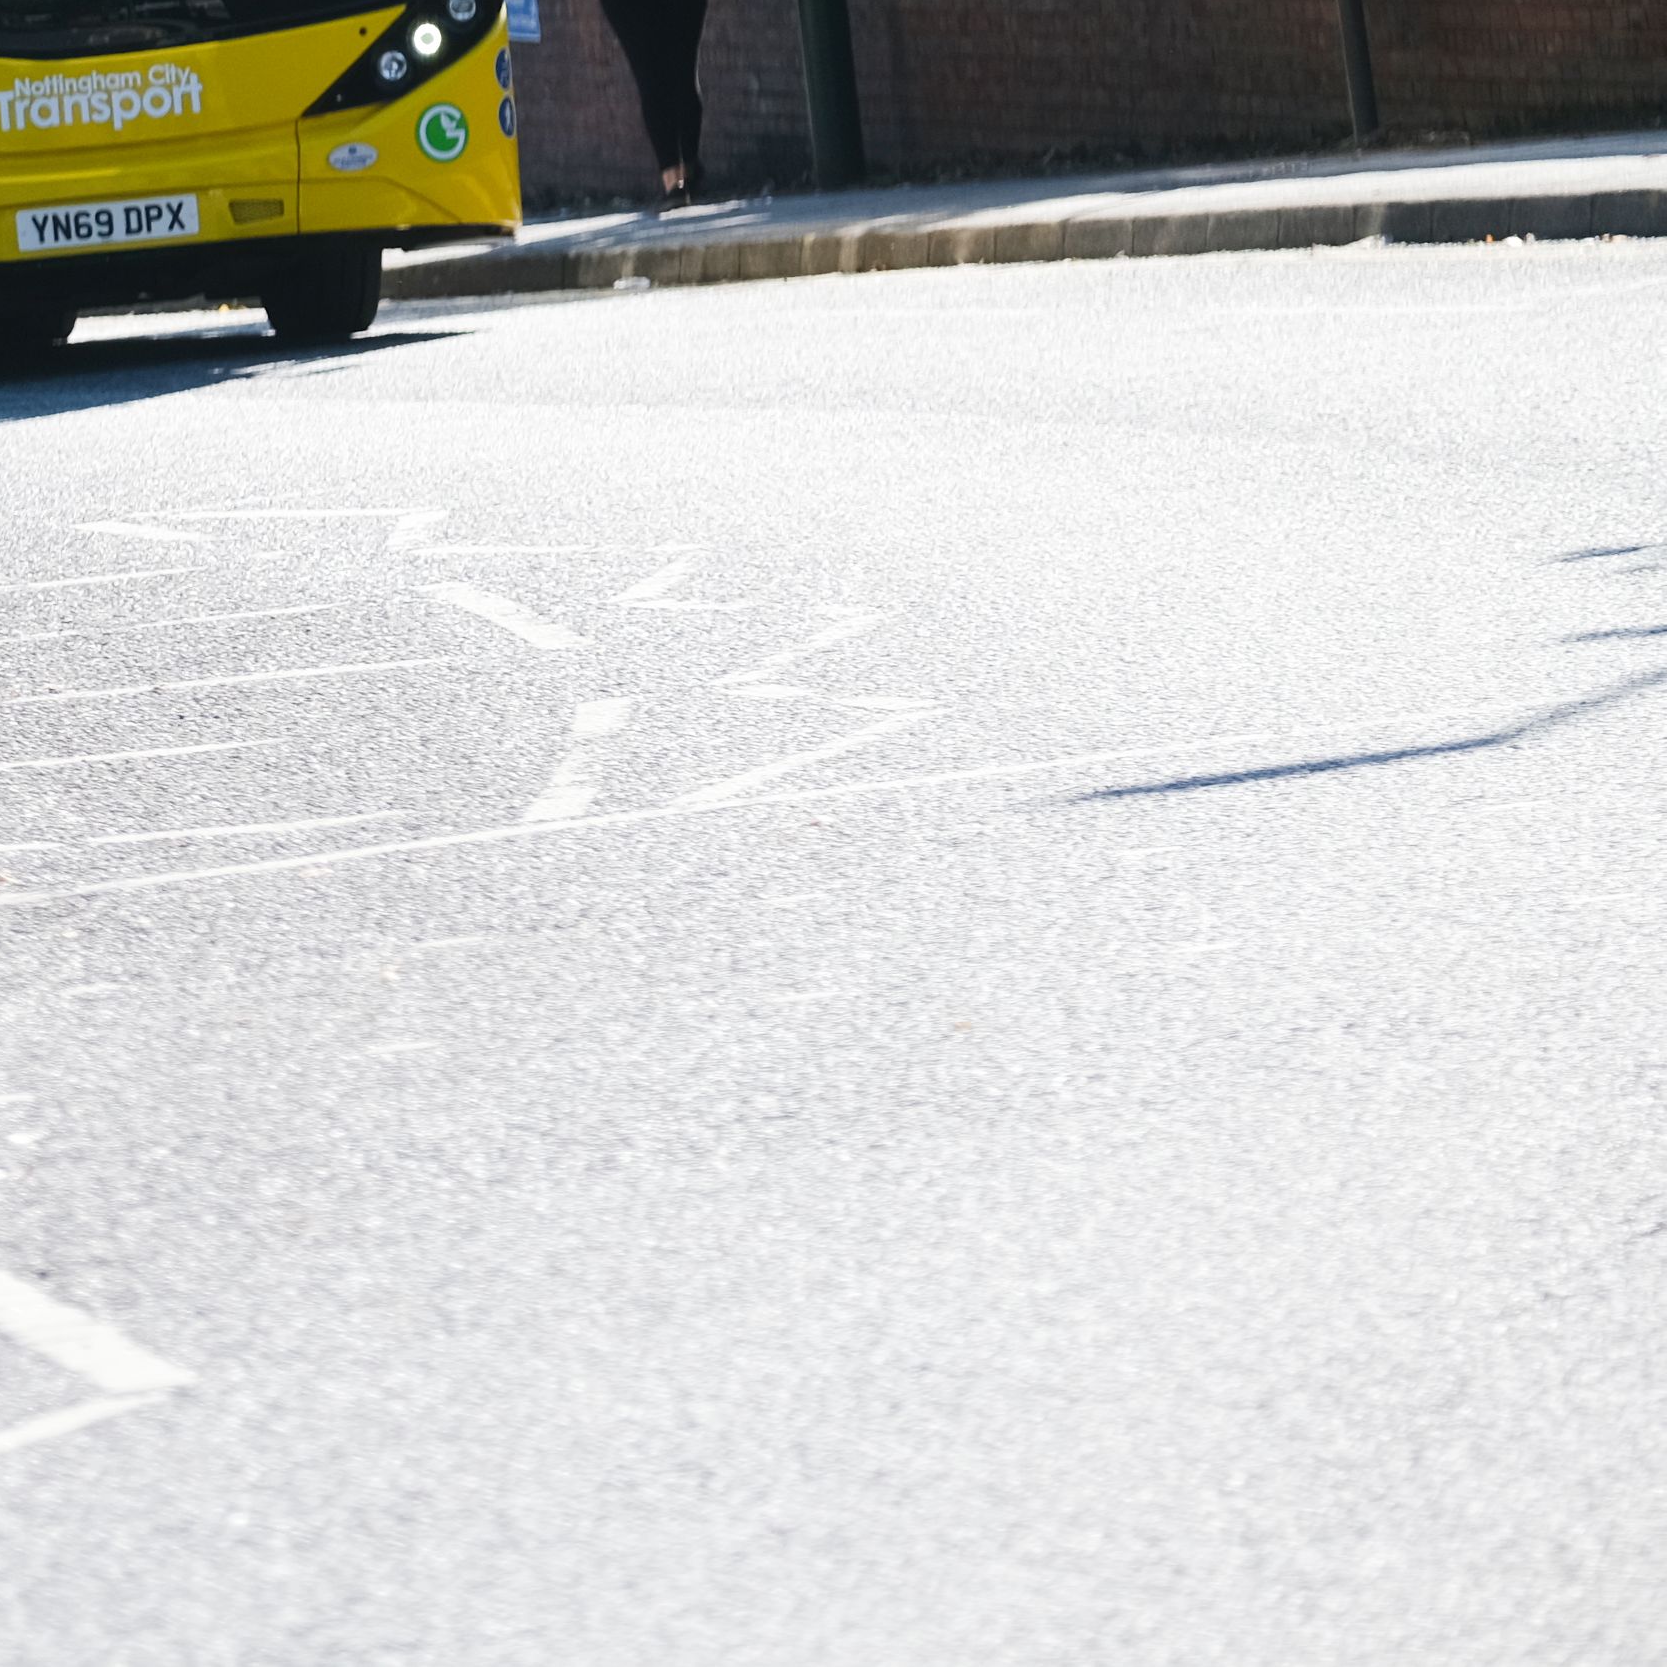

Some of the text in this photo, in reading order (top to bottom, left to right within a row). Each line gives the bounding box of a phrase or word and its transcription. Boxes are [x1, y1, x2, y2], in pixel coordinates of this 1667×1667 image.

[14, 62, 192, 97] Nottingham City
[31, 201, 187, 245] YN69 DPX
